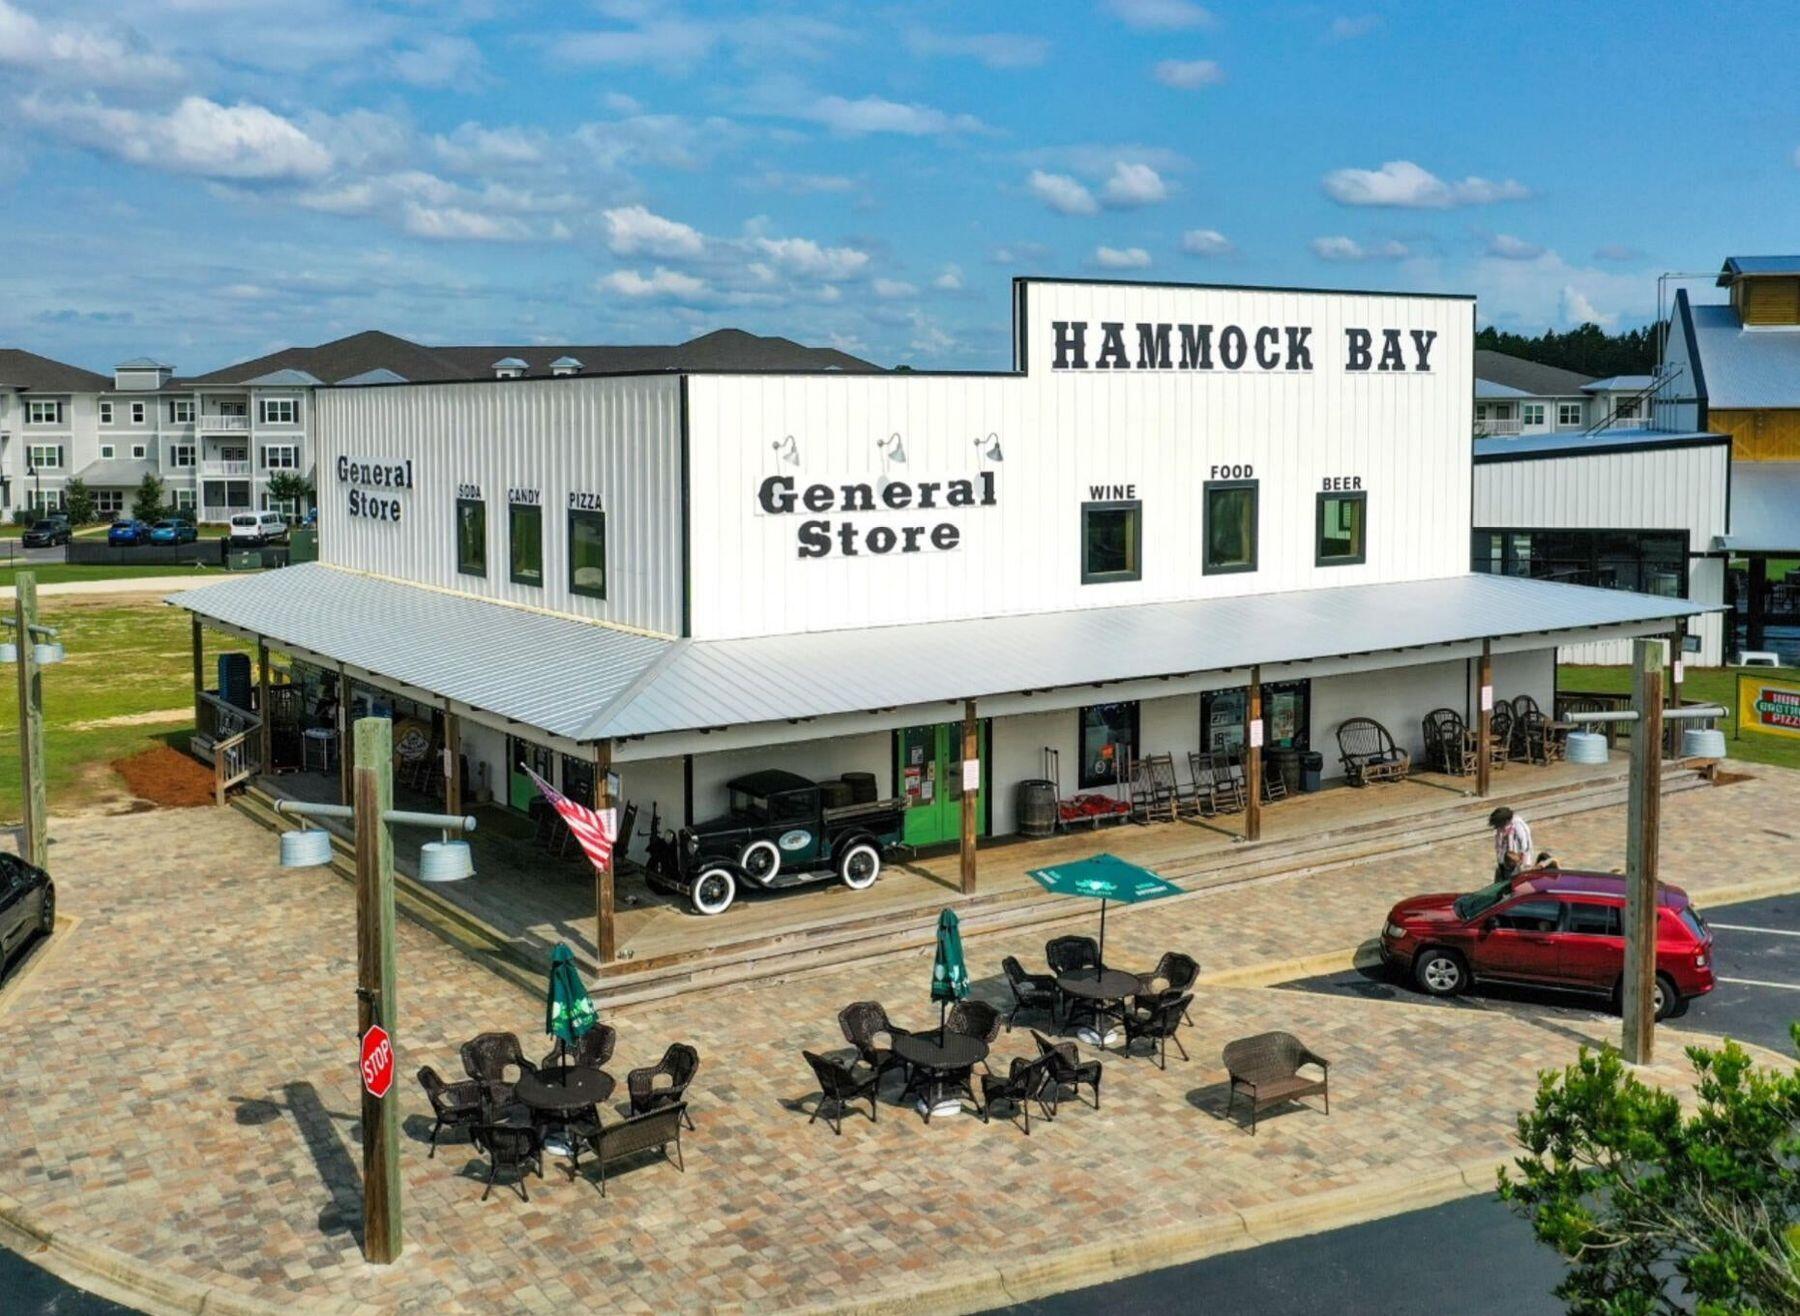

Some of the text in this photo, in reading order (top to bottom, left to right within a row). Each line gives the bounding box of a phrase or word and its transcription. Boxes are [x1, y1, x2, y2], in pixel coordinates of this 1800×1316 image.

[1052, 321, 1438, 371] HAMMOCK BAY
[338, 455, 413, 489] General
[1210, 465, 1254, 479] FOOD
[1322, 476, 1362, 491] BEER
[458, 484, 482, 499] SODA
[508, 488, 541, 503] CANDY
[569, 492, 602, 510] PIZZA
[758, 471, 997, 514] General
[1090, 484, 1136, 500] WINE
[349, 488, 401, 522] Store
[798, 520, 960, 558] Store
[364, 1039, 389, 1084] STOP
